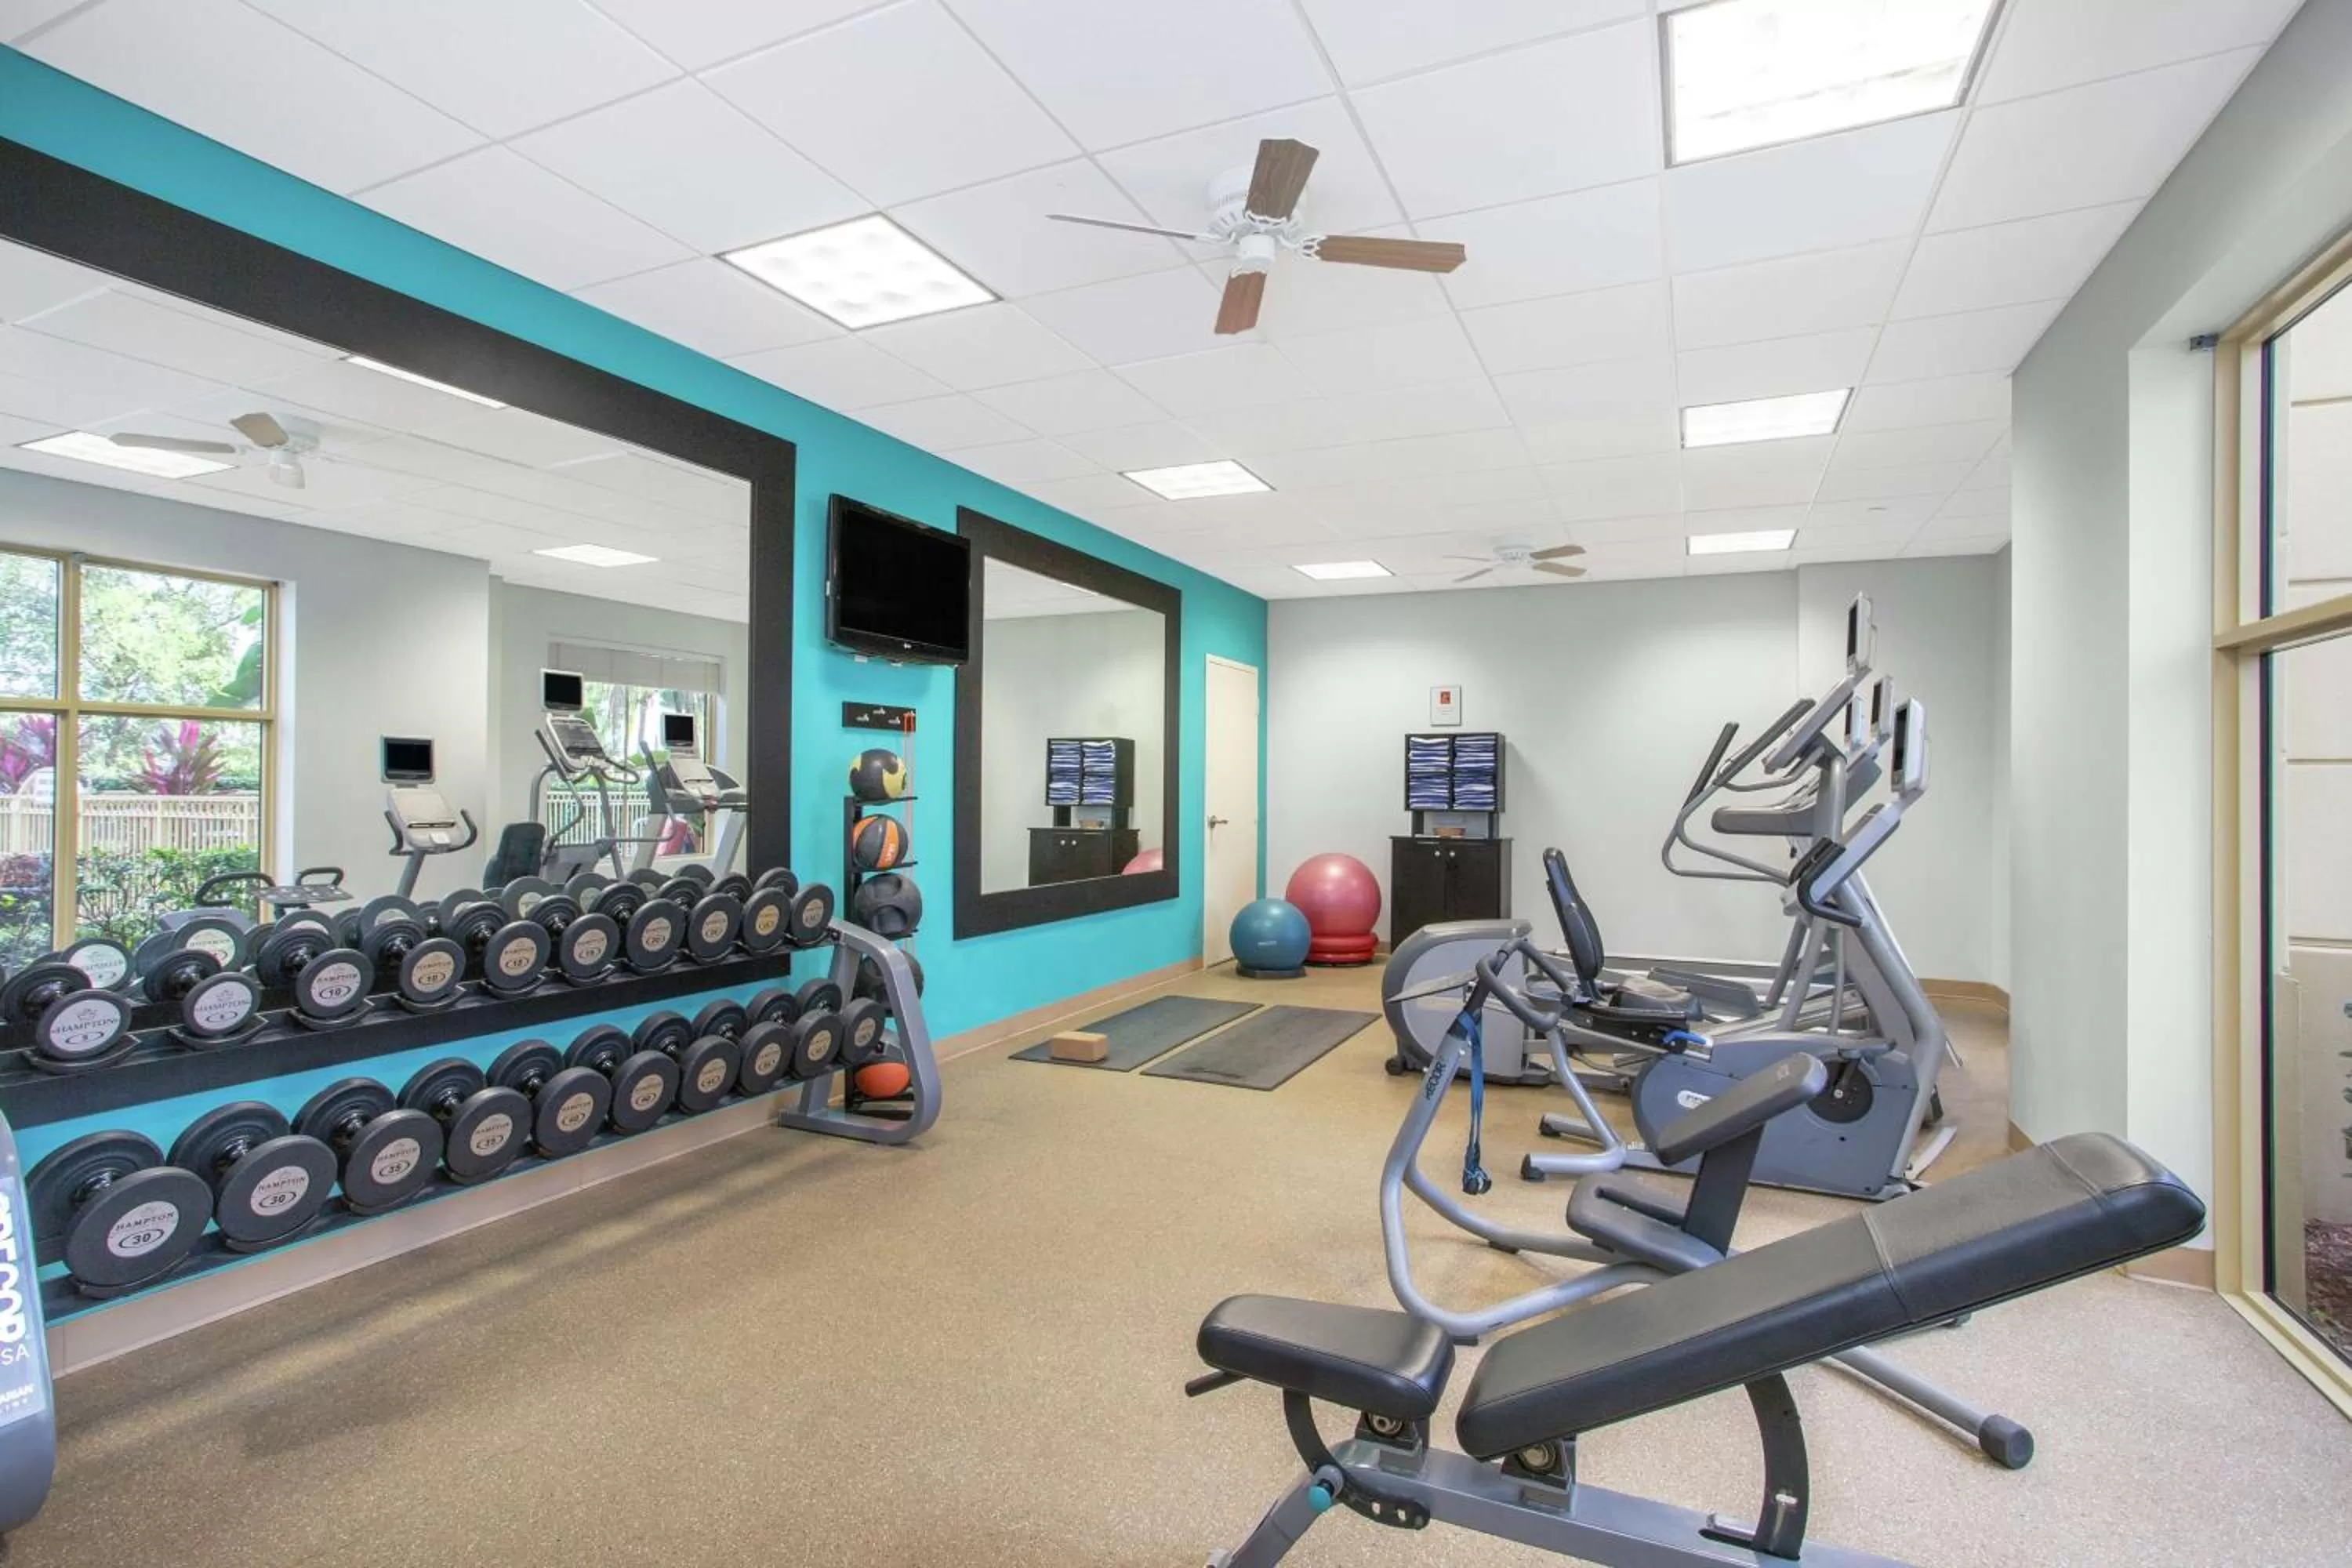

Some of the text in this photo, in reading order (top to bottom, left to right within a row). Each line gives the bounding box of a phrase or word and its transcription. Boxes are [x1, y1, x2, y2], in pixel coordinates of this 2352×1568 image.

[56, 1018, 114, 1034] HAMPTON
[270, 1194, 285, 1205] 30
[115, 1211, 174, 1232] HAMPTON
[132, 1232, 151, 1245] 30
